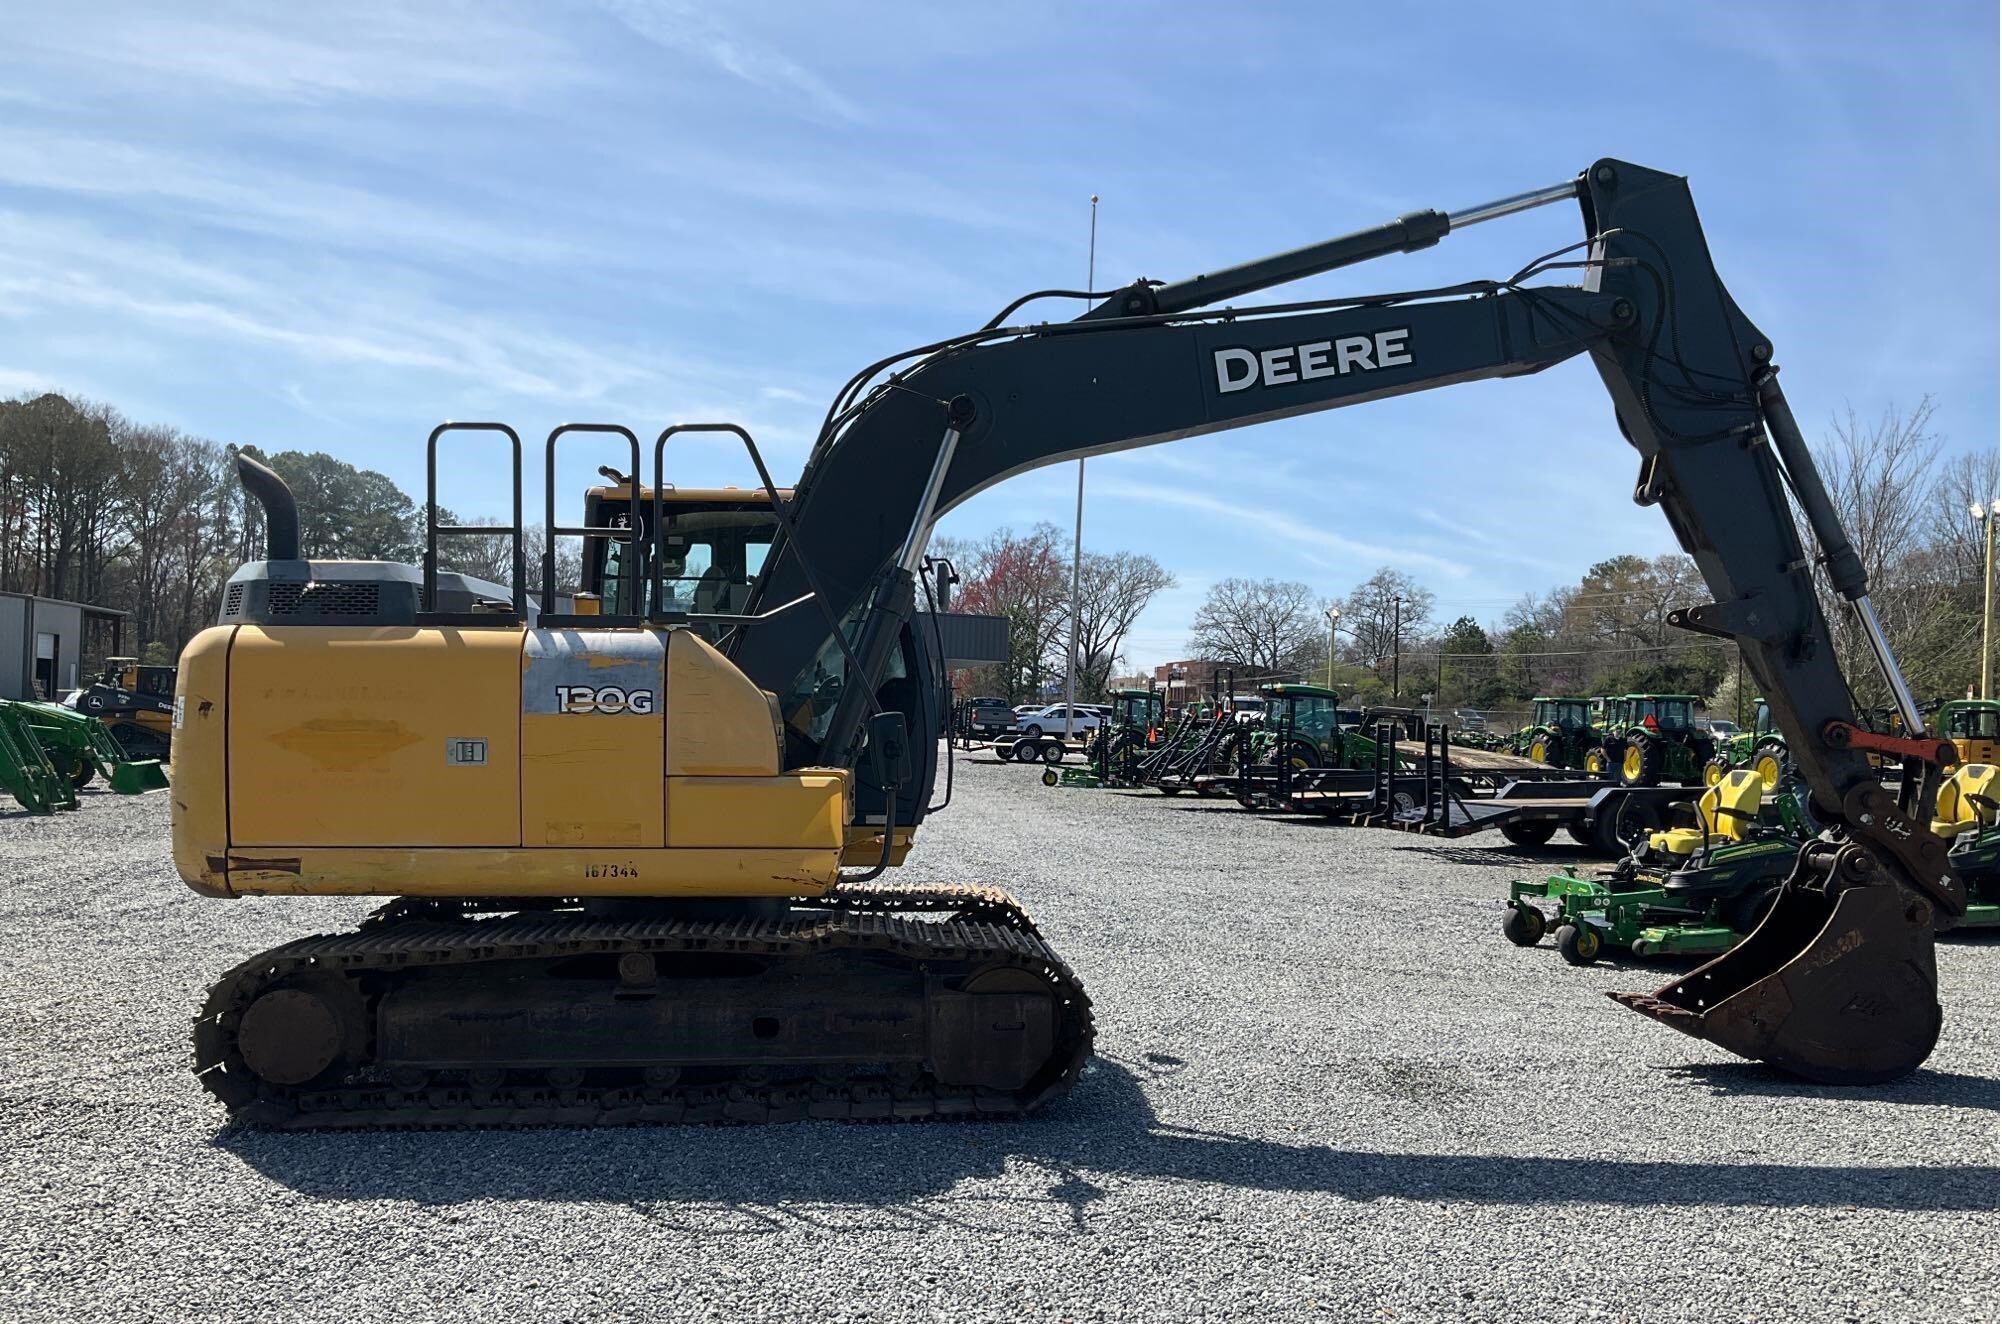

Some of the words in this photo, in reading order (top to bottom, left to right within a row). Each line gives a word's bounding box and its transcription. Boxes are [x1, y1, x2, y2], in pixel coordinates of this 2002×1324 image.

[1214, 328, 1413, 393] DEERE
[556, 686, 653, 714] 130G
[585, 864, 638, 878] 167344
